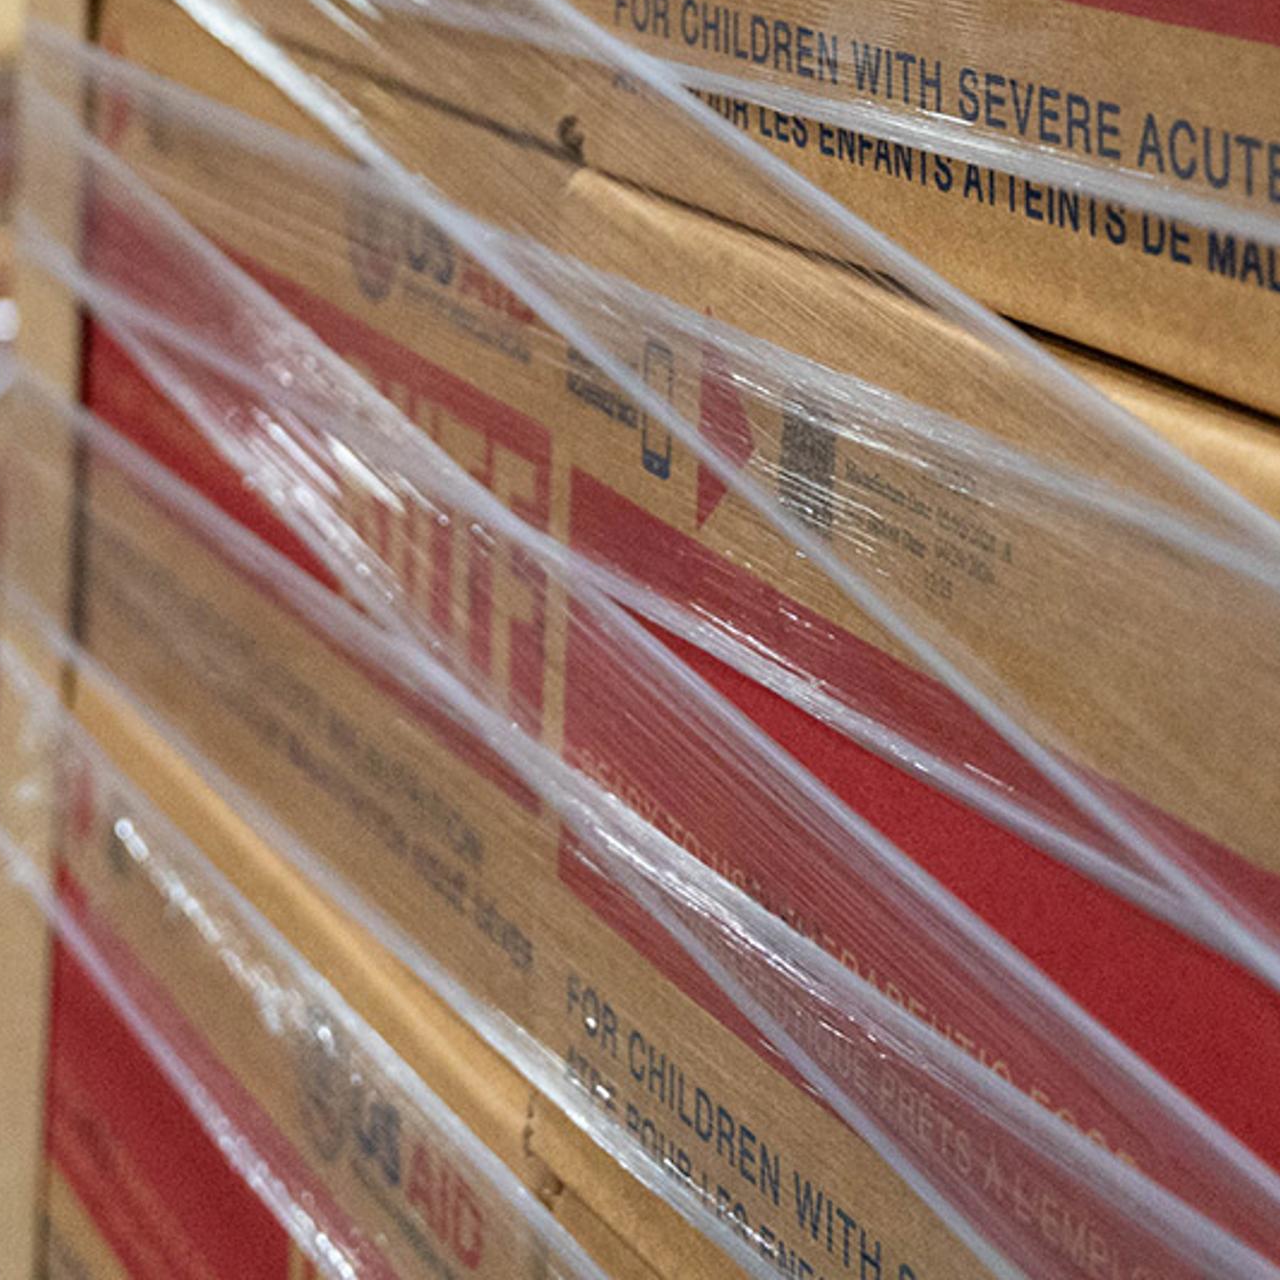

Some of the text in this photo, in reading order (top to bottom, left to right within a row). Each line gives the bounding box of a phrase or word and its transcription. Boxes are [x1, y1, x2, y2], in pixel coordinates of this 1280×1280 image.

[852, 39, 942, 114] WITH
[958, 67, 1121, 160] SEVERE
[567, 976, 618, 1055] FOR
[628, 1030, 780, 1206] CHILDREN
[794, 1171, 882, 1280] WITH
